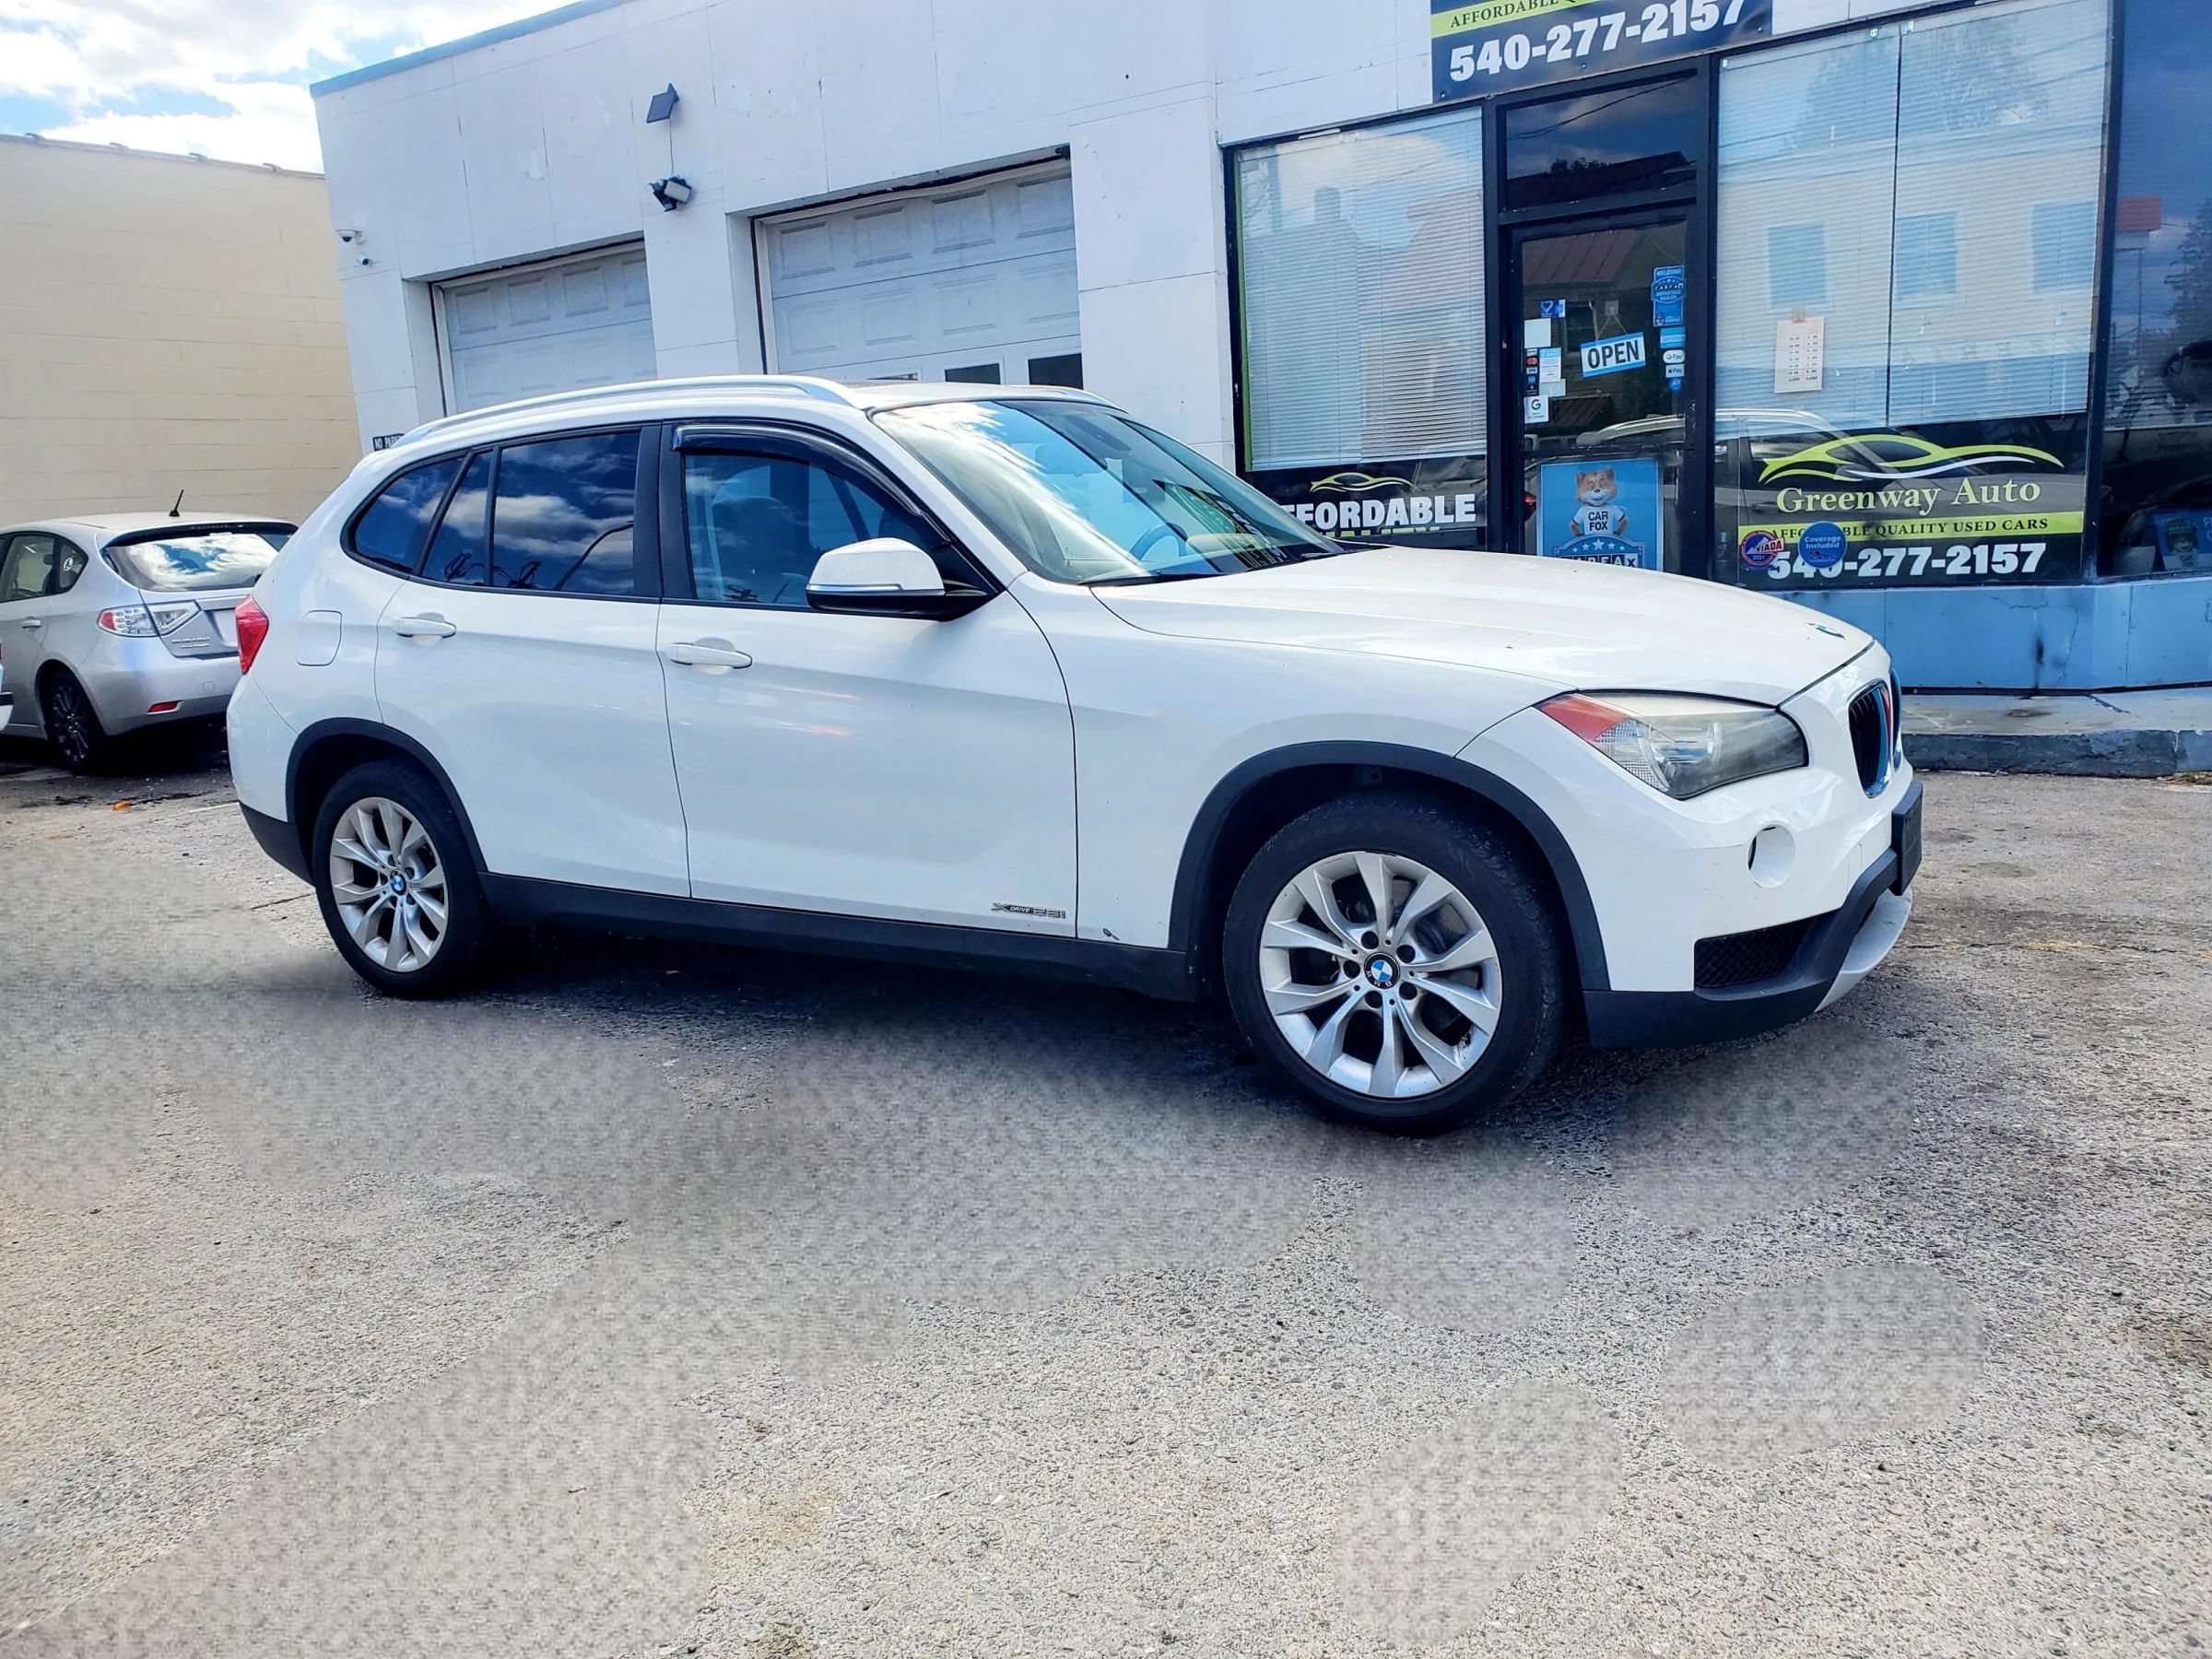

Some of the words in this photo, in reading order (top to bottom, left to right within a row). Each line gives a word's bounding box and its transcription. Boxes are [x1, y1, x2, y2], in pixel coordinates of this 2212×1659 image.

[1450, 0, 1745, 82] 540-277-2157
[1587, 339, 1640, 369] OPEN
[1776, 488, 1942, 516] Greenway
[1951, 477, 2041, 505] Auto
[1280, 494, 1477, 530] FORDABLE
[1588, 511, 1608, 521] CAR
[1589, 521, 1608, 531] FOX
[1875, 522, 1947, 536] QUALITY
[1953, 520, 1996, 532] USED
[2002, 518, 2048, 531] CARS
[1805, 535, 1841, 544] Coverage
